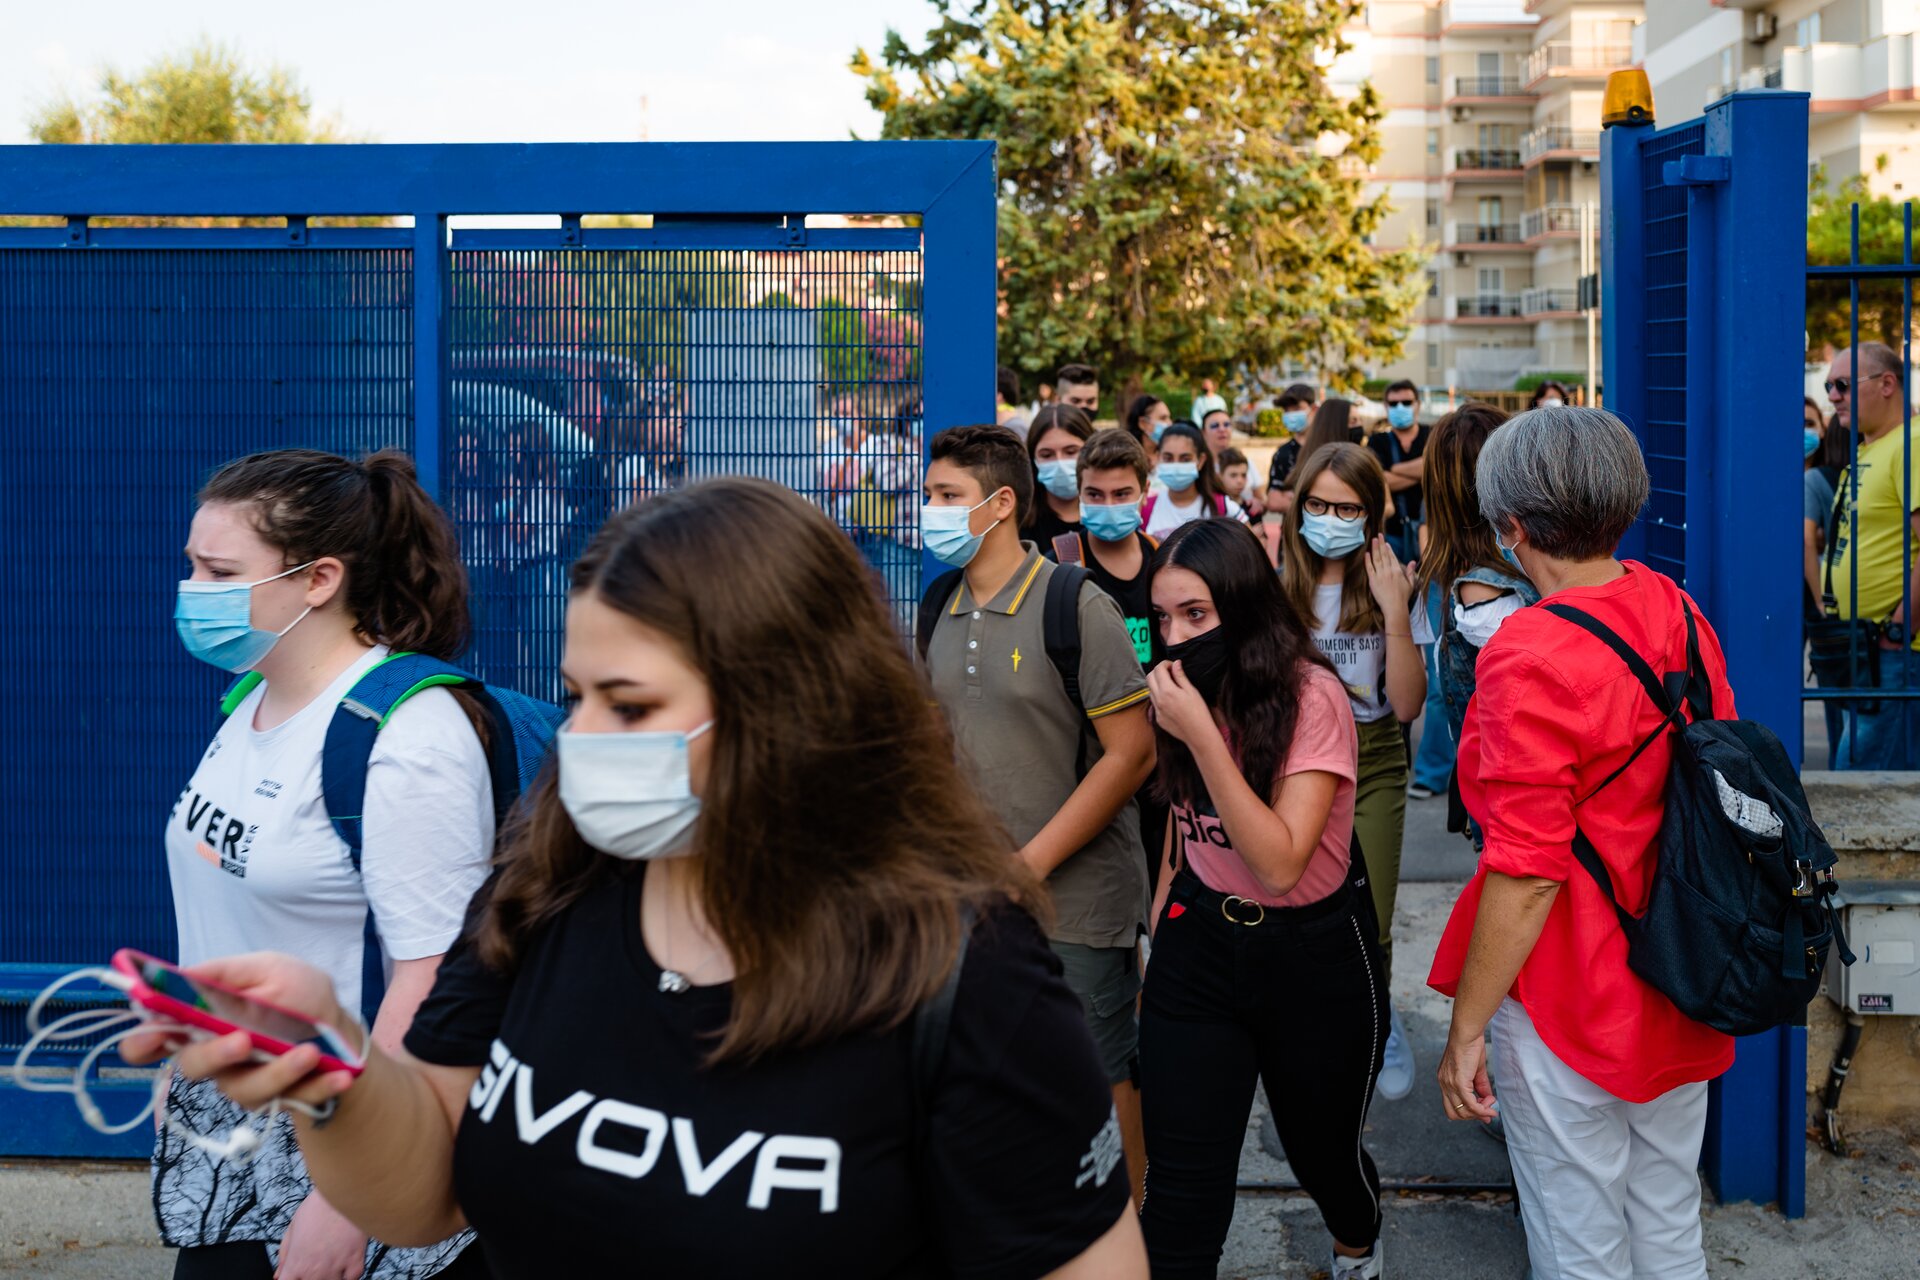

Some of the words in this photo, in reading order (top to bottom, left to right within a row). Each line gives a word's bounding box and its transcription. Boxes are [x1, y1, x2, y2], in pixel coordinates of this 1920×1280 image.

[1359, 636, 1381, 652] SAYS
[1334, 652, 1347, 665] DO
[1349, 651, 1358, 665] IT
[469, 1037, 842, 1214] GIVOVA
